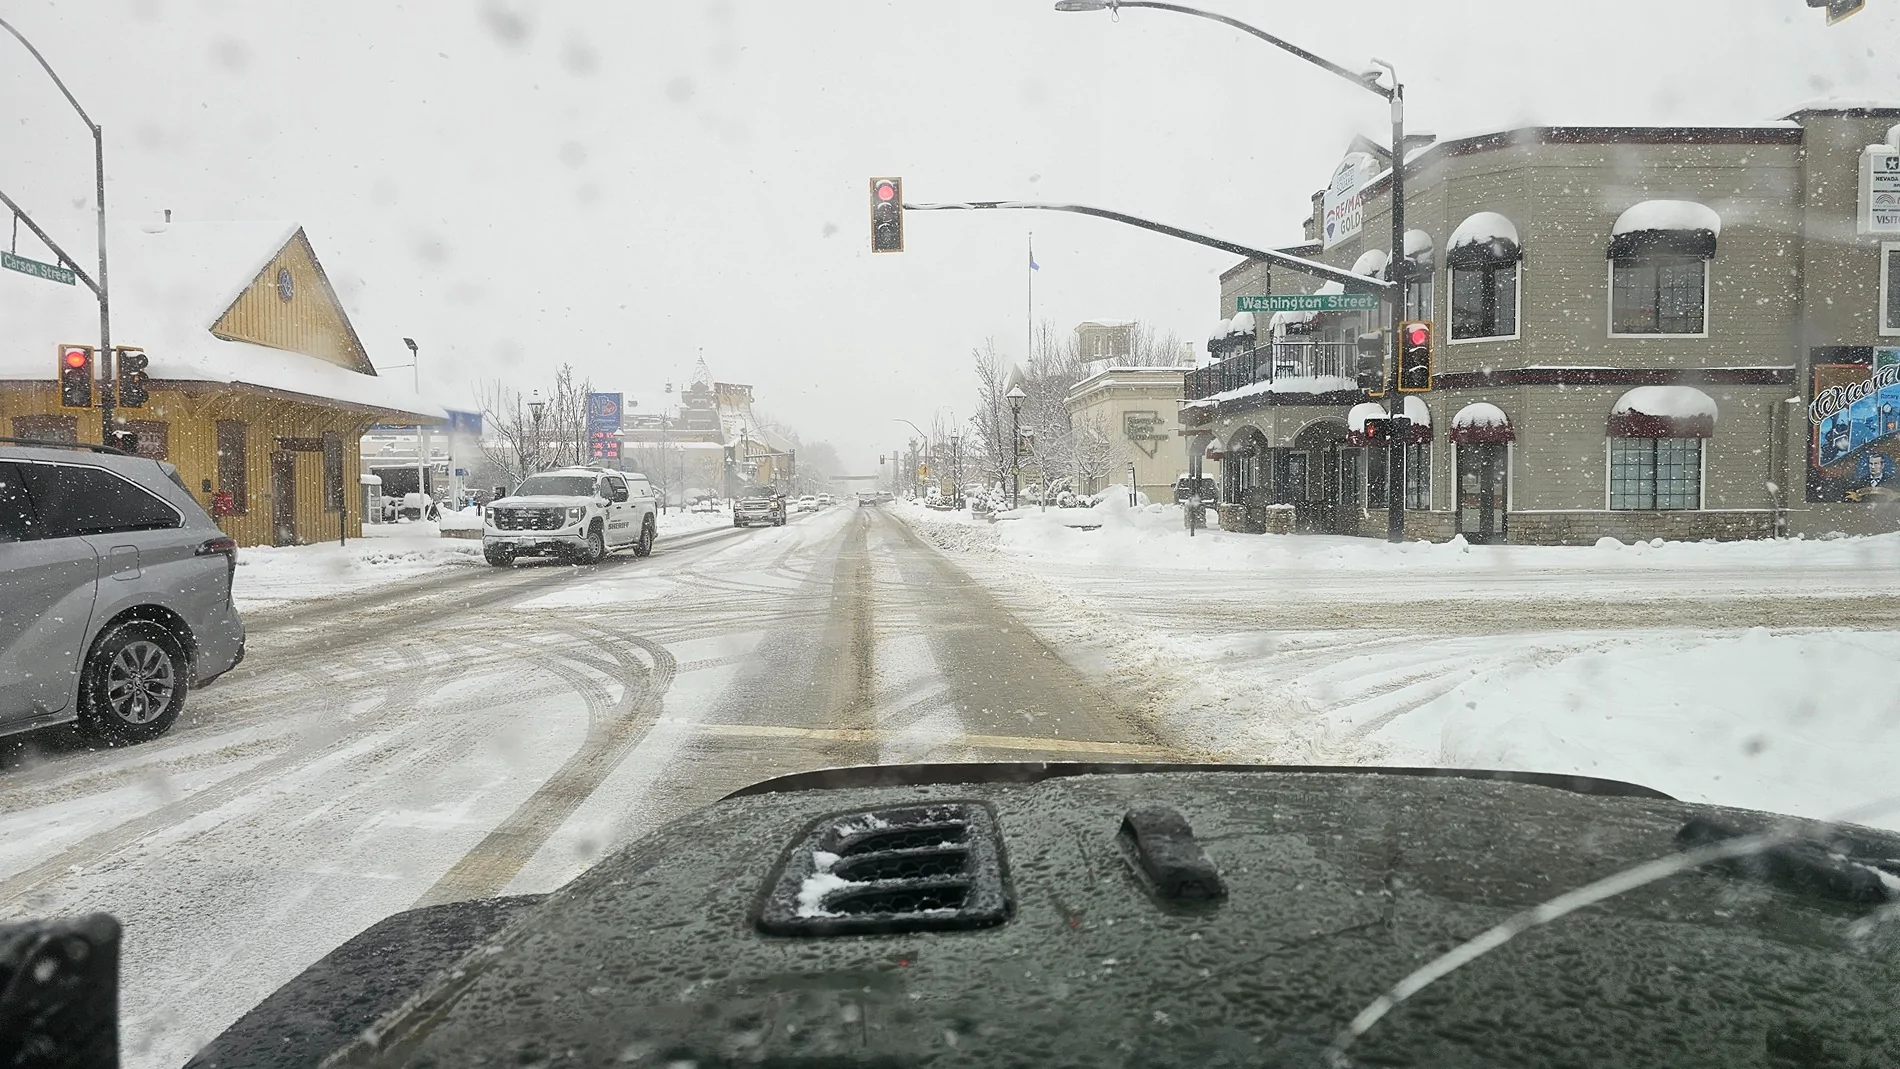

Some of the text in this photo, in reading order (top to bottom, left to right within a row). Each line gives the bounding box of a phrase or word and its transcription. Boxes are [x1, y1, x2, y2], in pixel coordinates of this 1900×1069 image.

[1340, 212, 1361, 235] GOLD
[1876, 215, 1900, 224] VISIT
[4, 254, 74, 283] Carson Street
[1242, 296, 1373, 310] Washington Street
[1808, 365, 1895, 425] Welcome
[608, 521, 630, 530] SHERIFF
